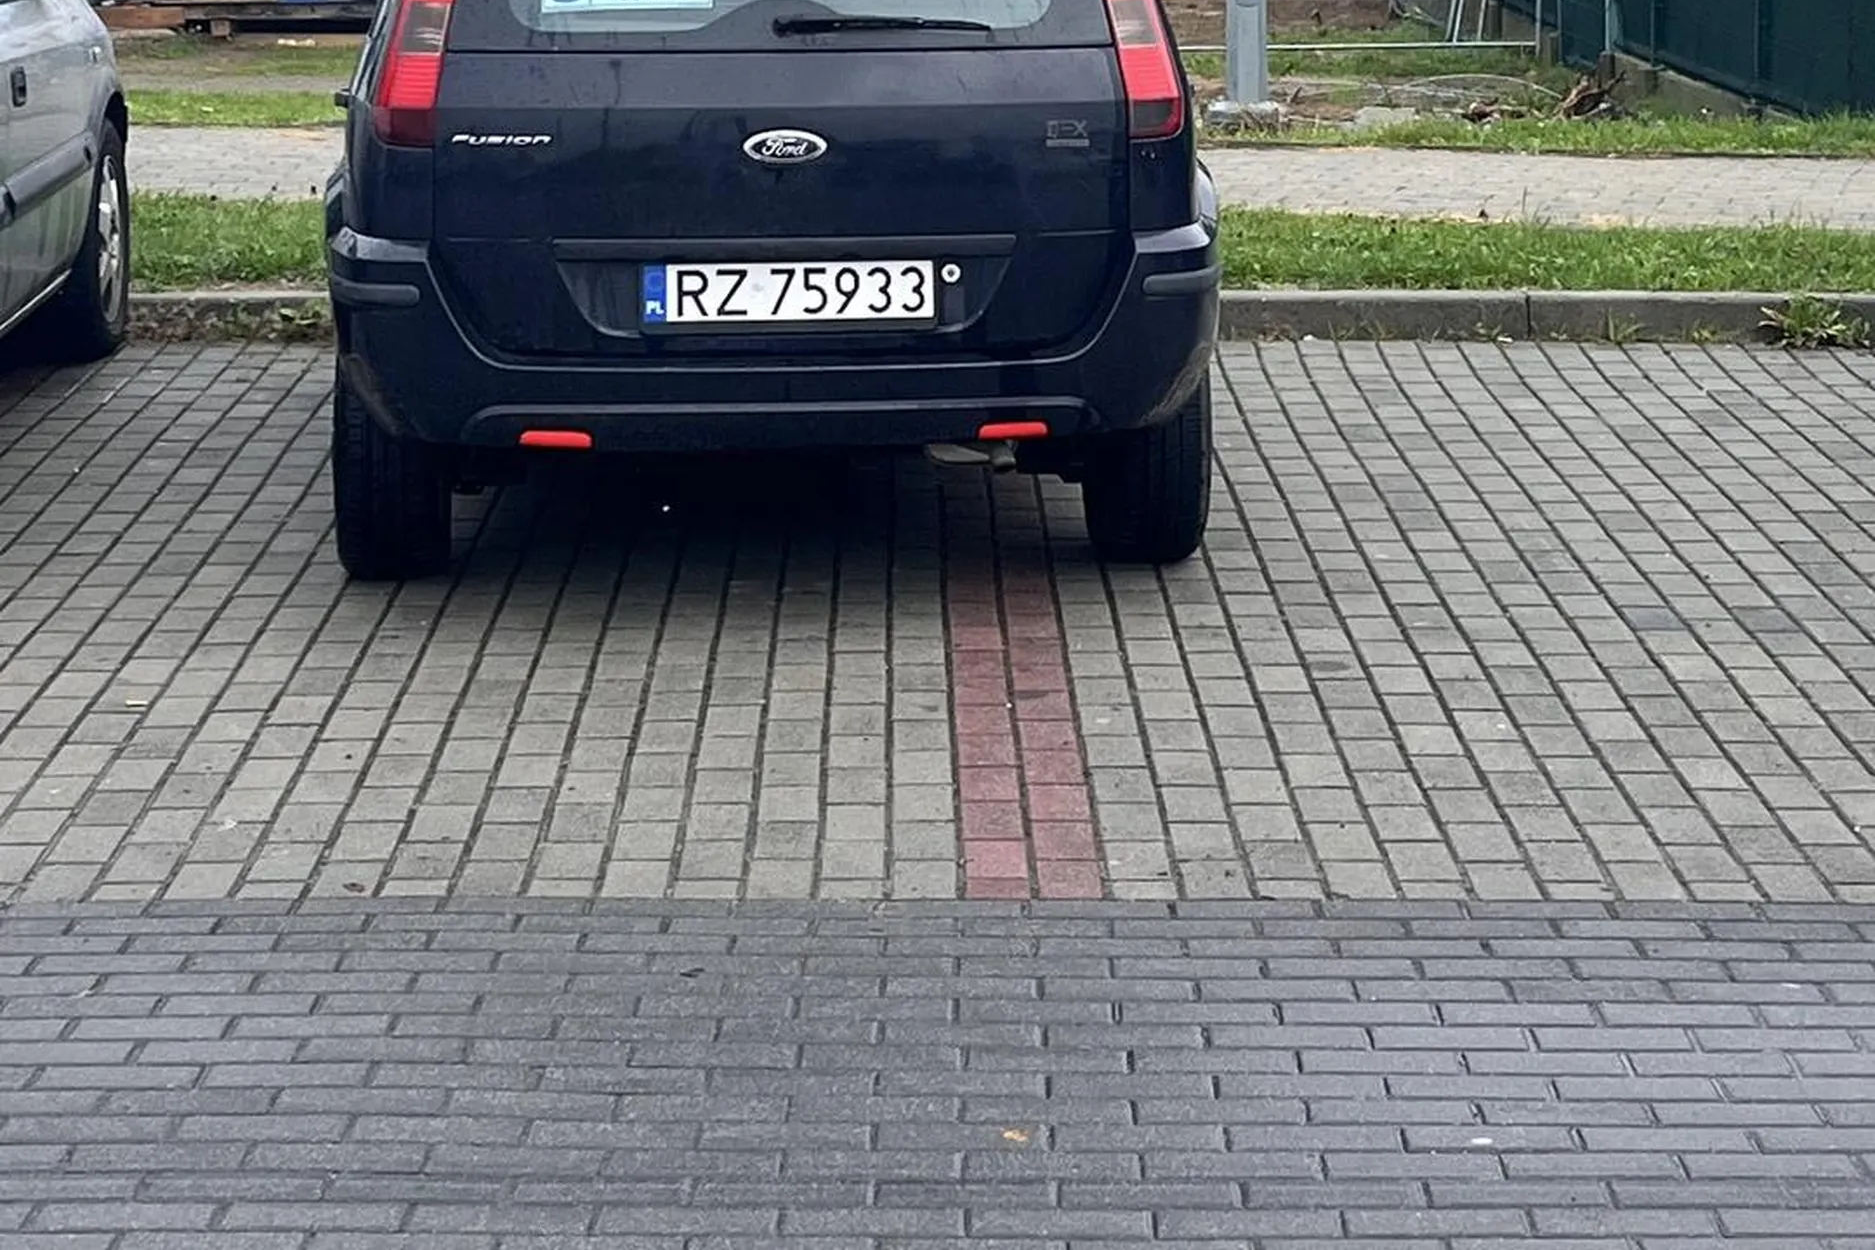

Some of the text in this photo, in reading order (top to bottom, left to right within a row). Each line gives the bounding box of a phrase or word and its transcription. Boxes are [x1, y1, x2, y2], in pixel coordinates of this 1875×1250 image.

[761, 137, 809, 157] Ford
[676, 266, 926, 317] RZ 75933
[645, 300, 665, 315] PL
